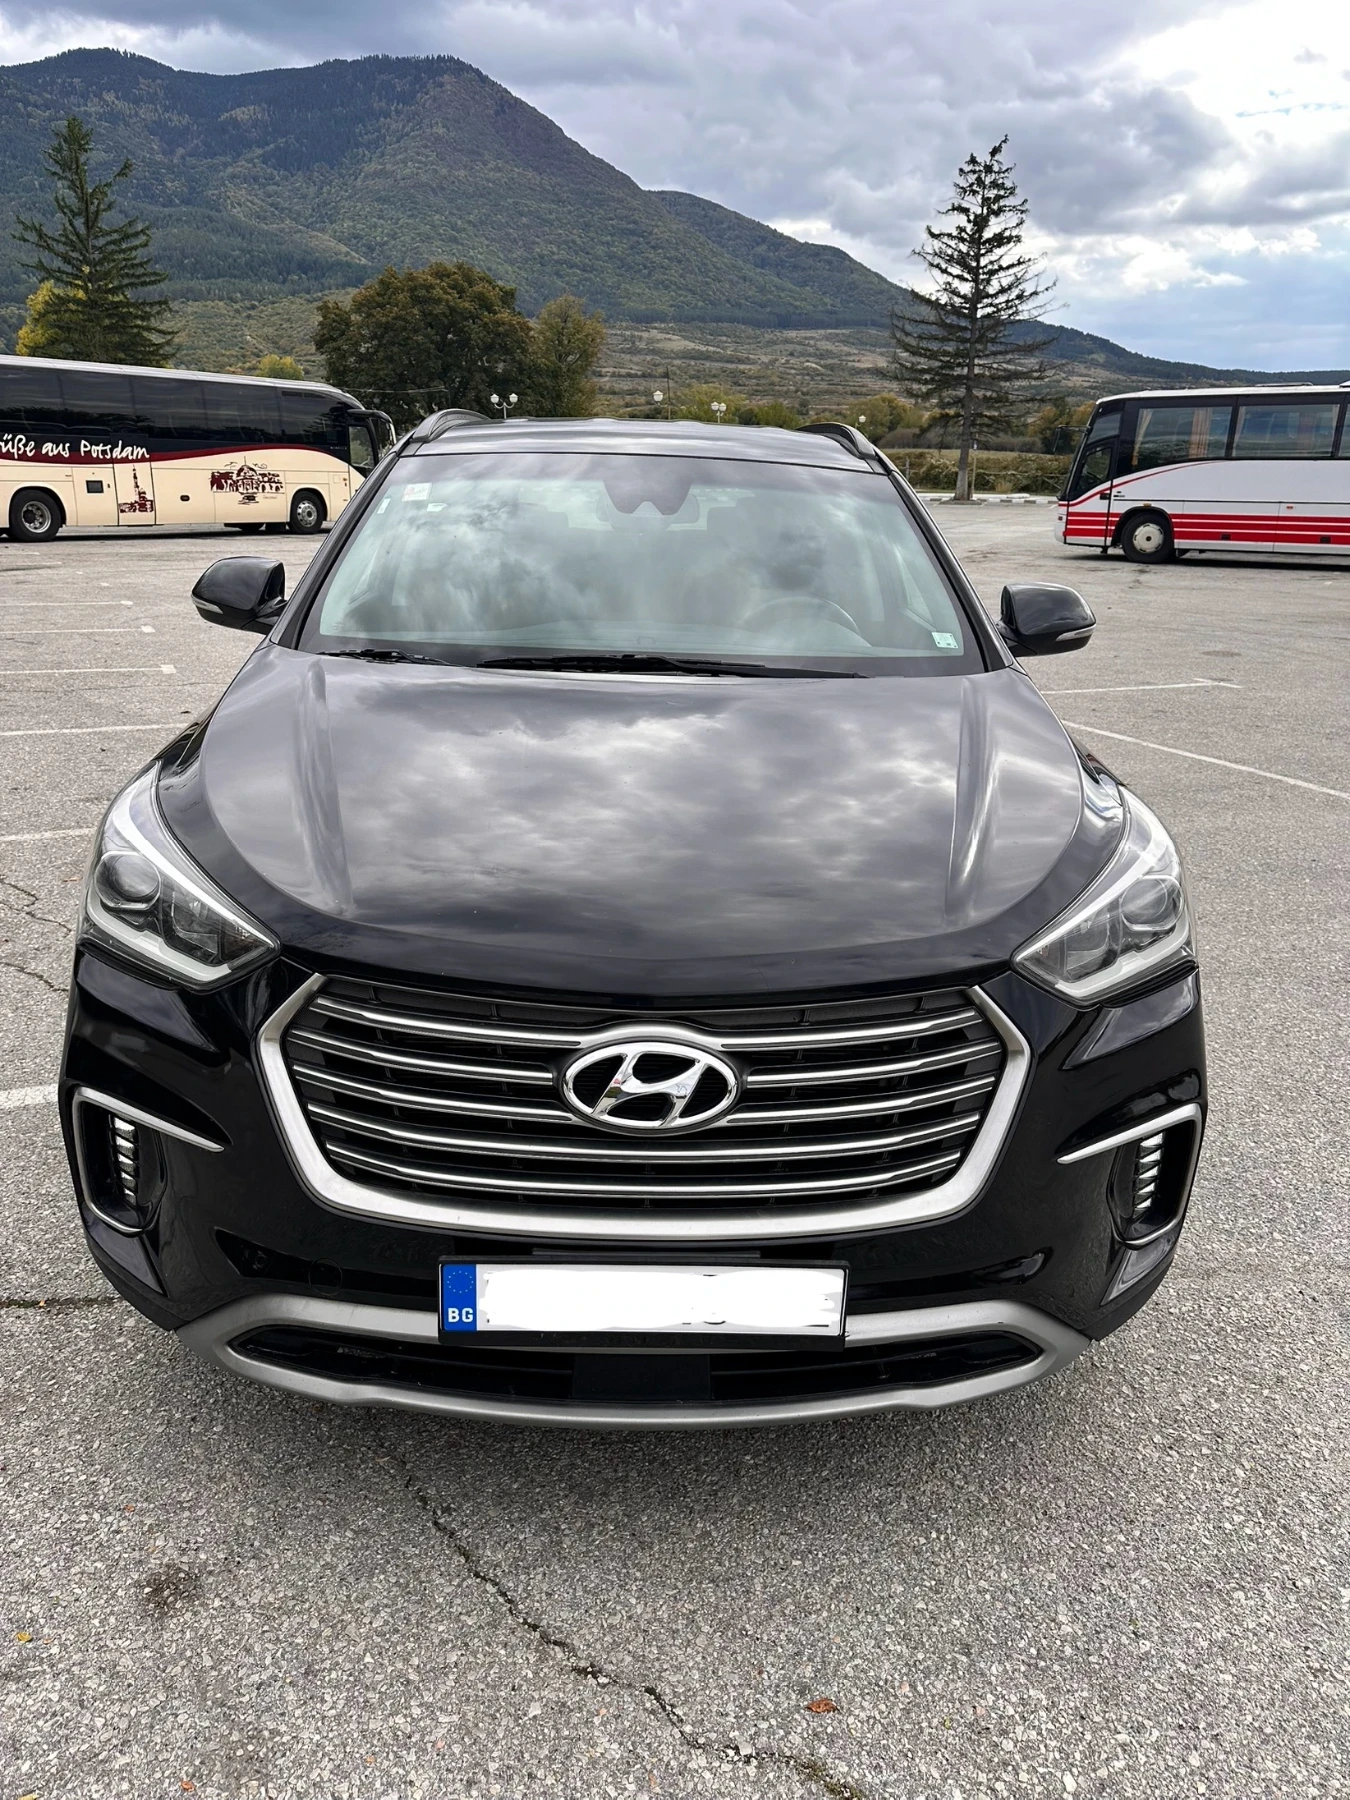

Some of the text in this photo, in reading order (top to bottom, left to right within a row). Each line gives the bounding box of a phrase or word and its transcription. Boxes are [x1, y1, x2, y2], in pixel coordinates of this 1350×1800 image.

[41, 442, 70, 458] aus
[80, 439, 150, 460] Potsdam
[448, 1307, 474, 1323] BG
